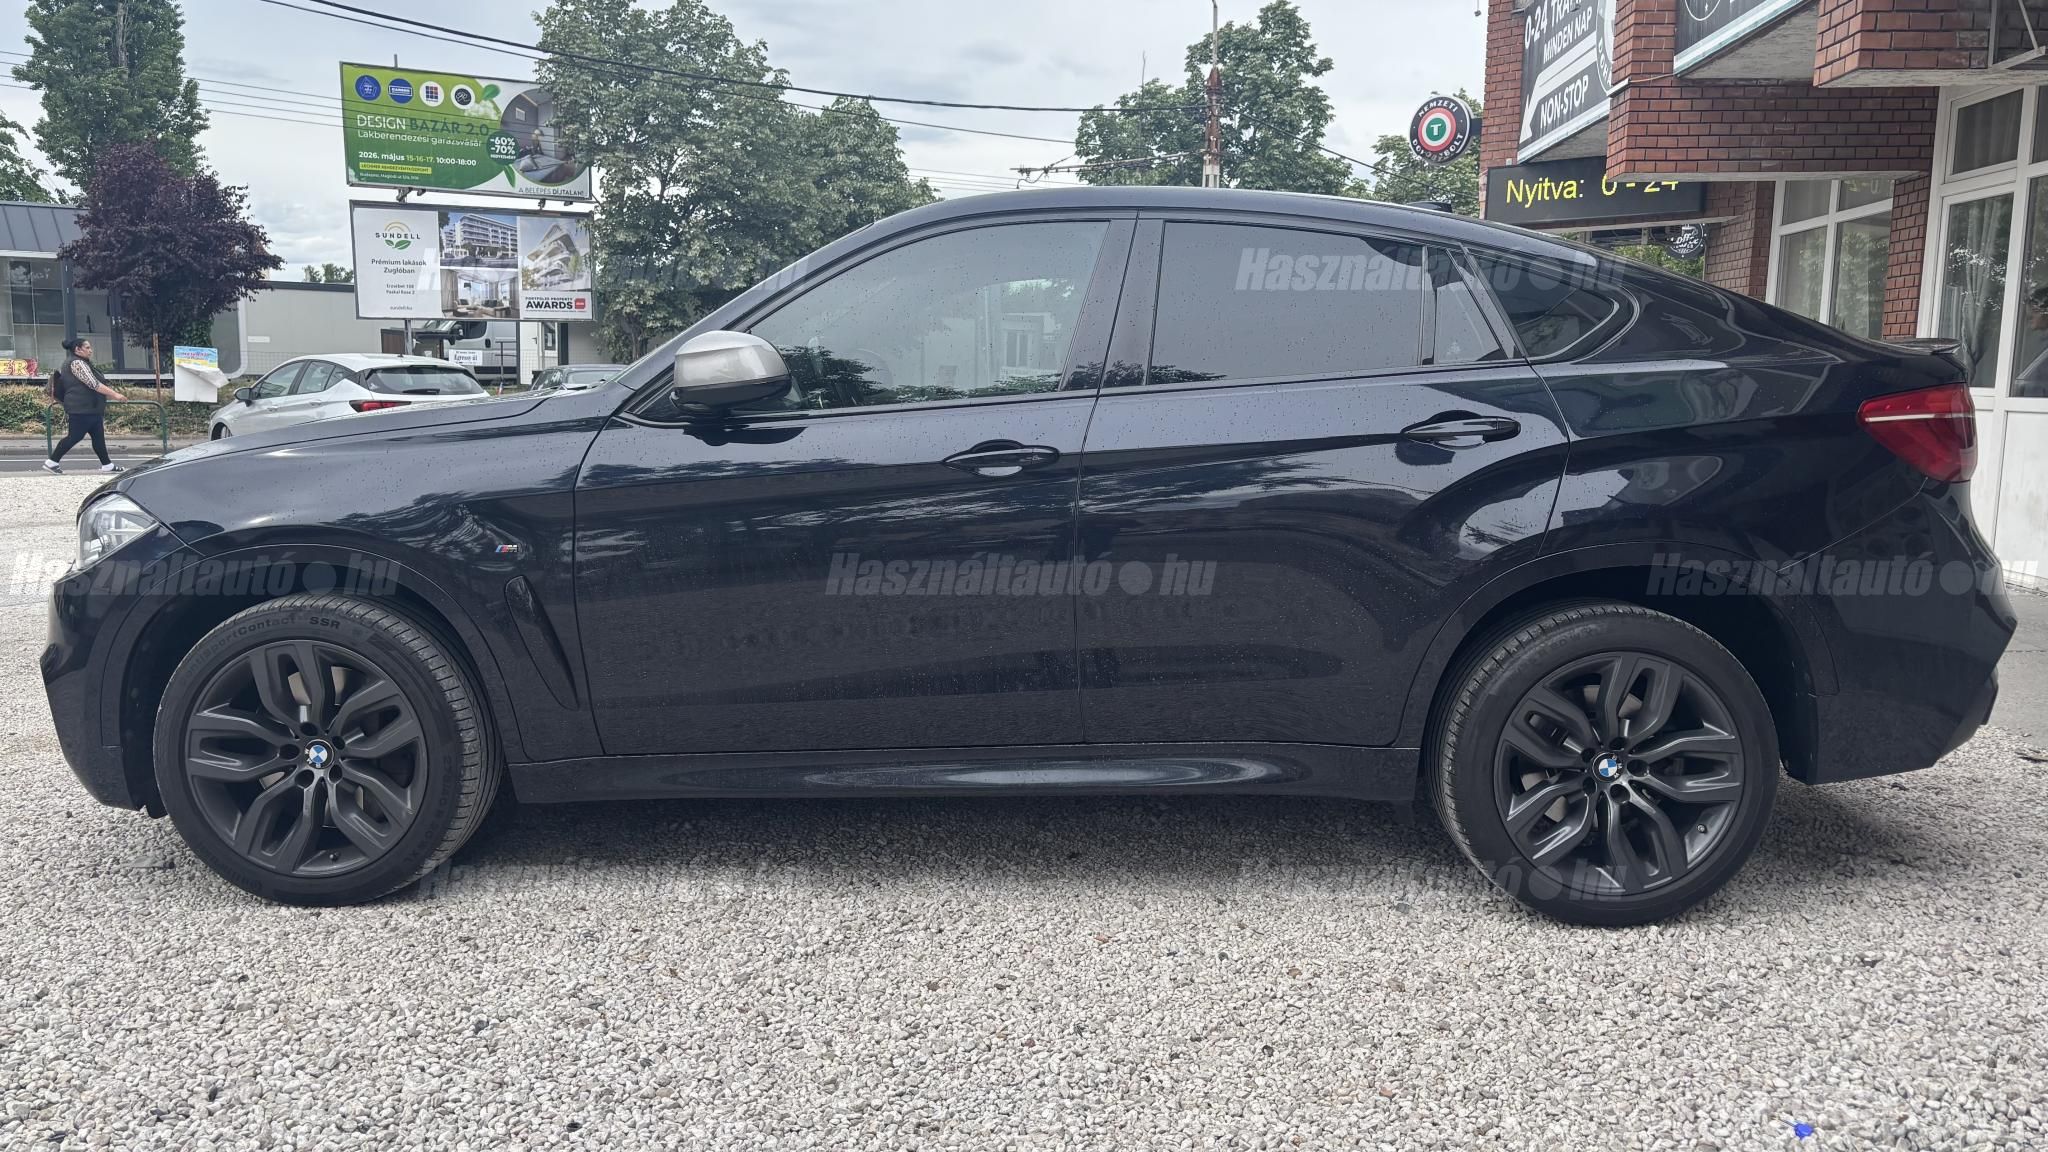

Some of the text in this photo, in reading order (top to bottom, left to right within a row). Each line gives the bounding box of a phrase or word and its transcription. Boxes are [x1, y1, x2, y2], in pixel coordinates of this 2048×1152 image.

[1543, 6, 1593, 64] MINDEN NAP
[1418, 99, 1459, 117] NEMZETI
[1540, 74, 1589, 129] NON-STOP
[357, 114, 489, 136] DESIGN BAZÁR 2.0
[1430, 123, 1442, 136] T
[357, 130, 429, 143] Lakberendezési
[490, 137, 516, 146] -60%
[490, 145, 516, 155] -70%
[358, 151, 380, 160] 2026.
[381, 152, 405, 162] május
[436, 157, 477, 166] 10:00-18:00
[1506, 176, 1585, 208] Nyitva:
[375, 232, 421, 240] SUNDELL
[371, 258, 402, 266] Prémium
[383, 267, 416, 275] Zuglóban
[526, 301, 573, 310] AWARDS
[309, 616, 341, 630] SSR
